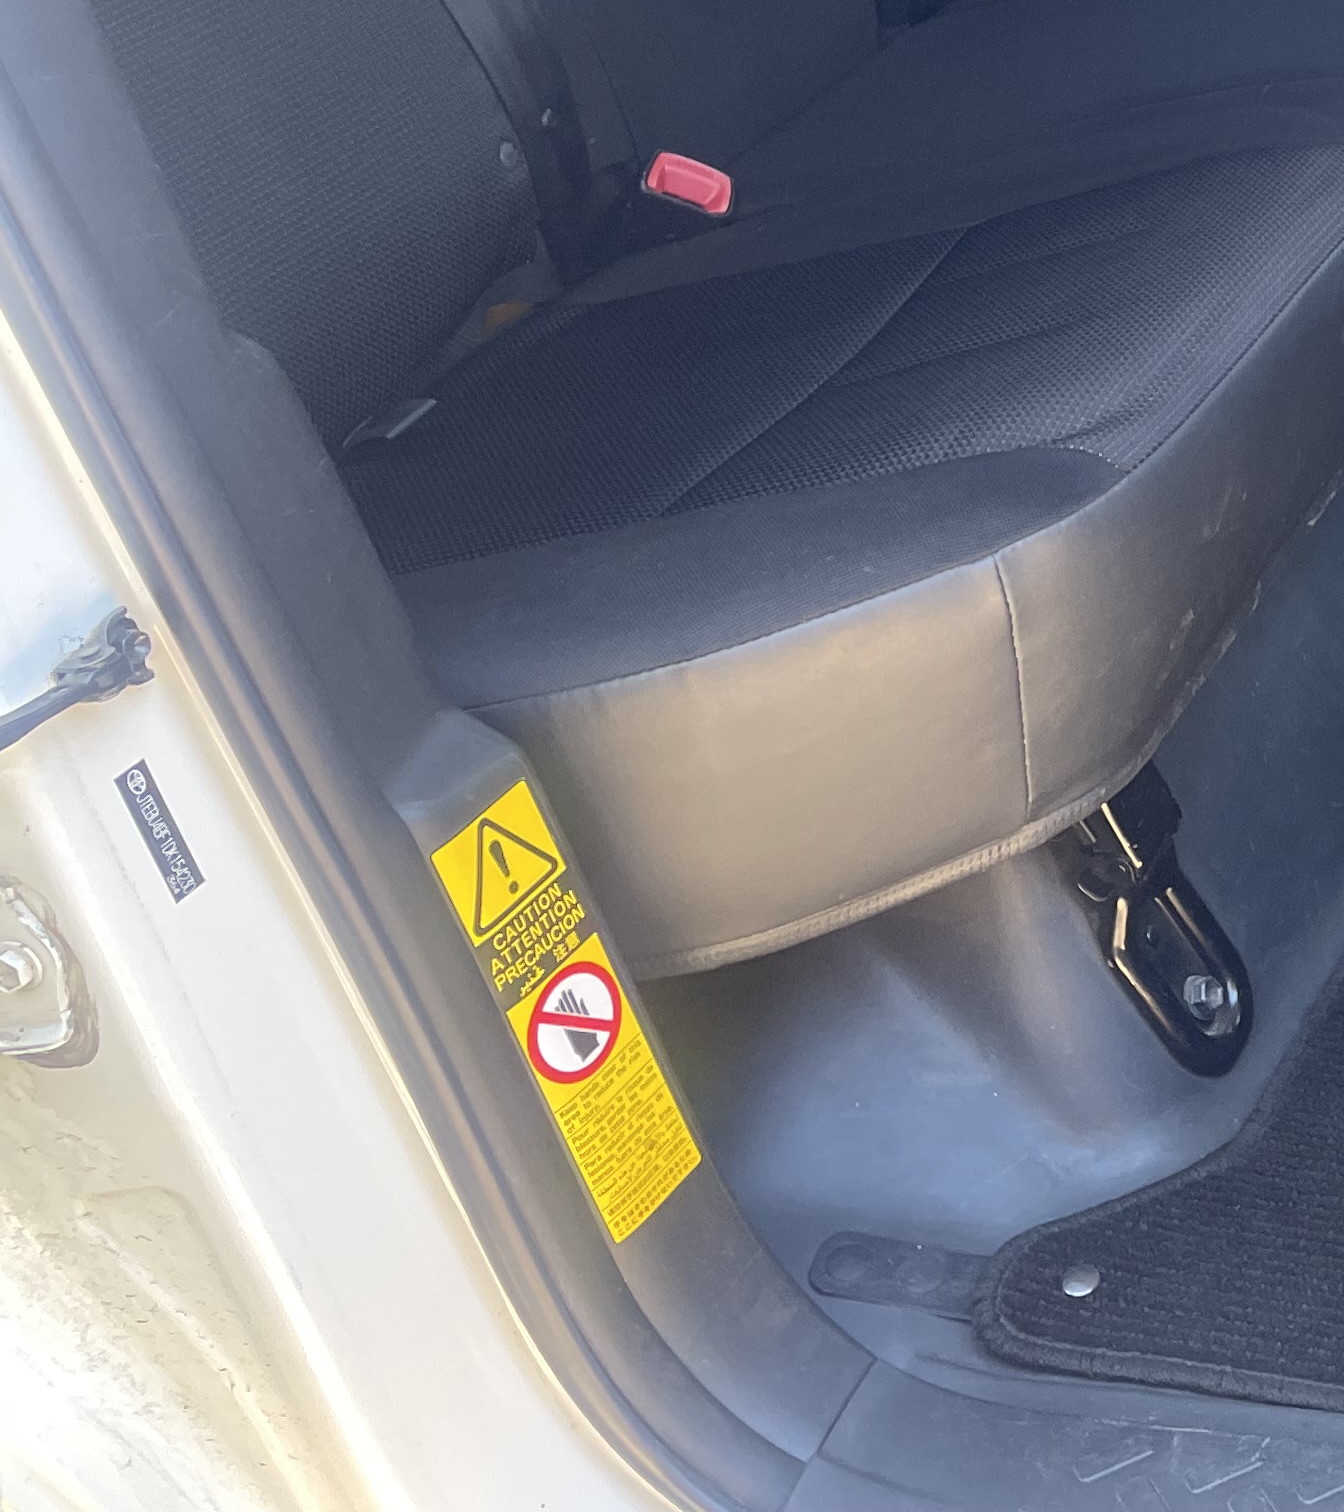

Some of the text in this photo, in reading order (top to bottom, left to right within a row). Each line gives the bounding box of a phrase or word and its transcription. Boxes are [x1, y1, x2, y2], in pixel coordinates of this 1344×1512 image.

[491, 889, 576, 976] ATTENTION
[492, 882, 562, 950] CAUTION
[494, 903, 585, 992] PRECAUCION
